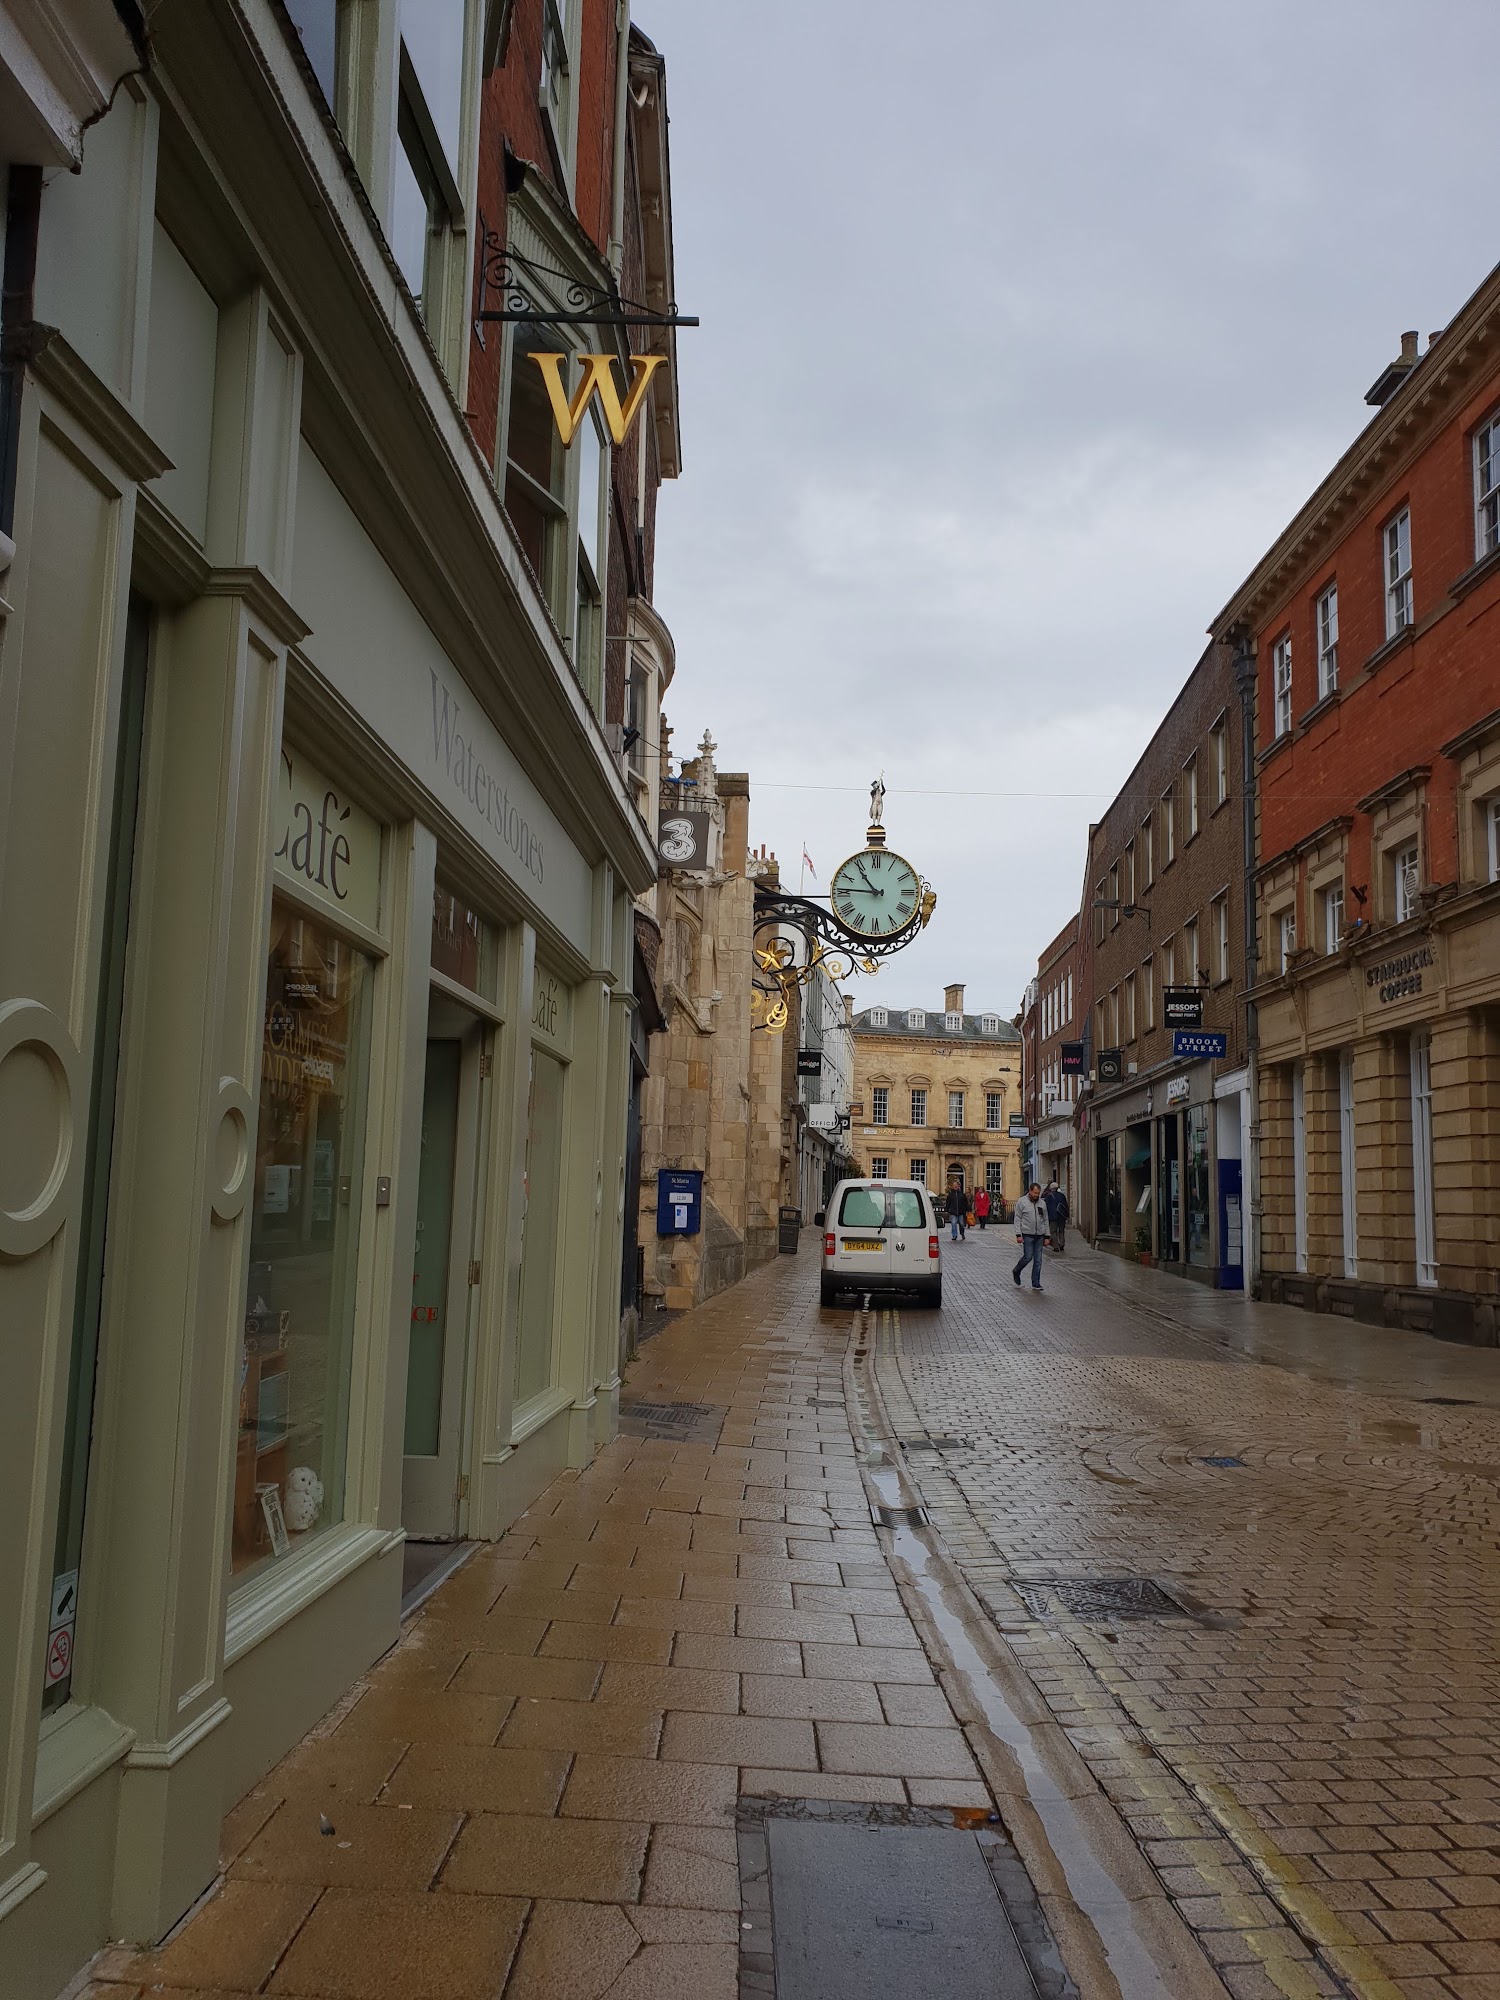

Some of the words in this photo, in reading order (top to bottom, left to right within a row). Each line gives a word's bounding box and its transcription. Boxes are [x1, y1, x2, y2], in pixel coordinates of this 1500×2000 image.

[527, 353, 668, 449] W
[429, 666, 544, 885] Waterstones
[660, 818, 697, 862] 3
[872, 855, 881, 869] XII
[1366, 947, 1433, 987] STARBUCKS
[1379, 973, 1422, 1003] COFFEE
[1166, 1004, 1200, 1012] JESSOPS
[1177, 1044, 1222, 1052] STREET
[1181, 1037, 1218, 1046] BROOK
[867, 1242, 880, 1250] UXZ
